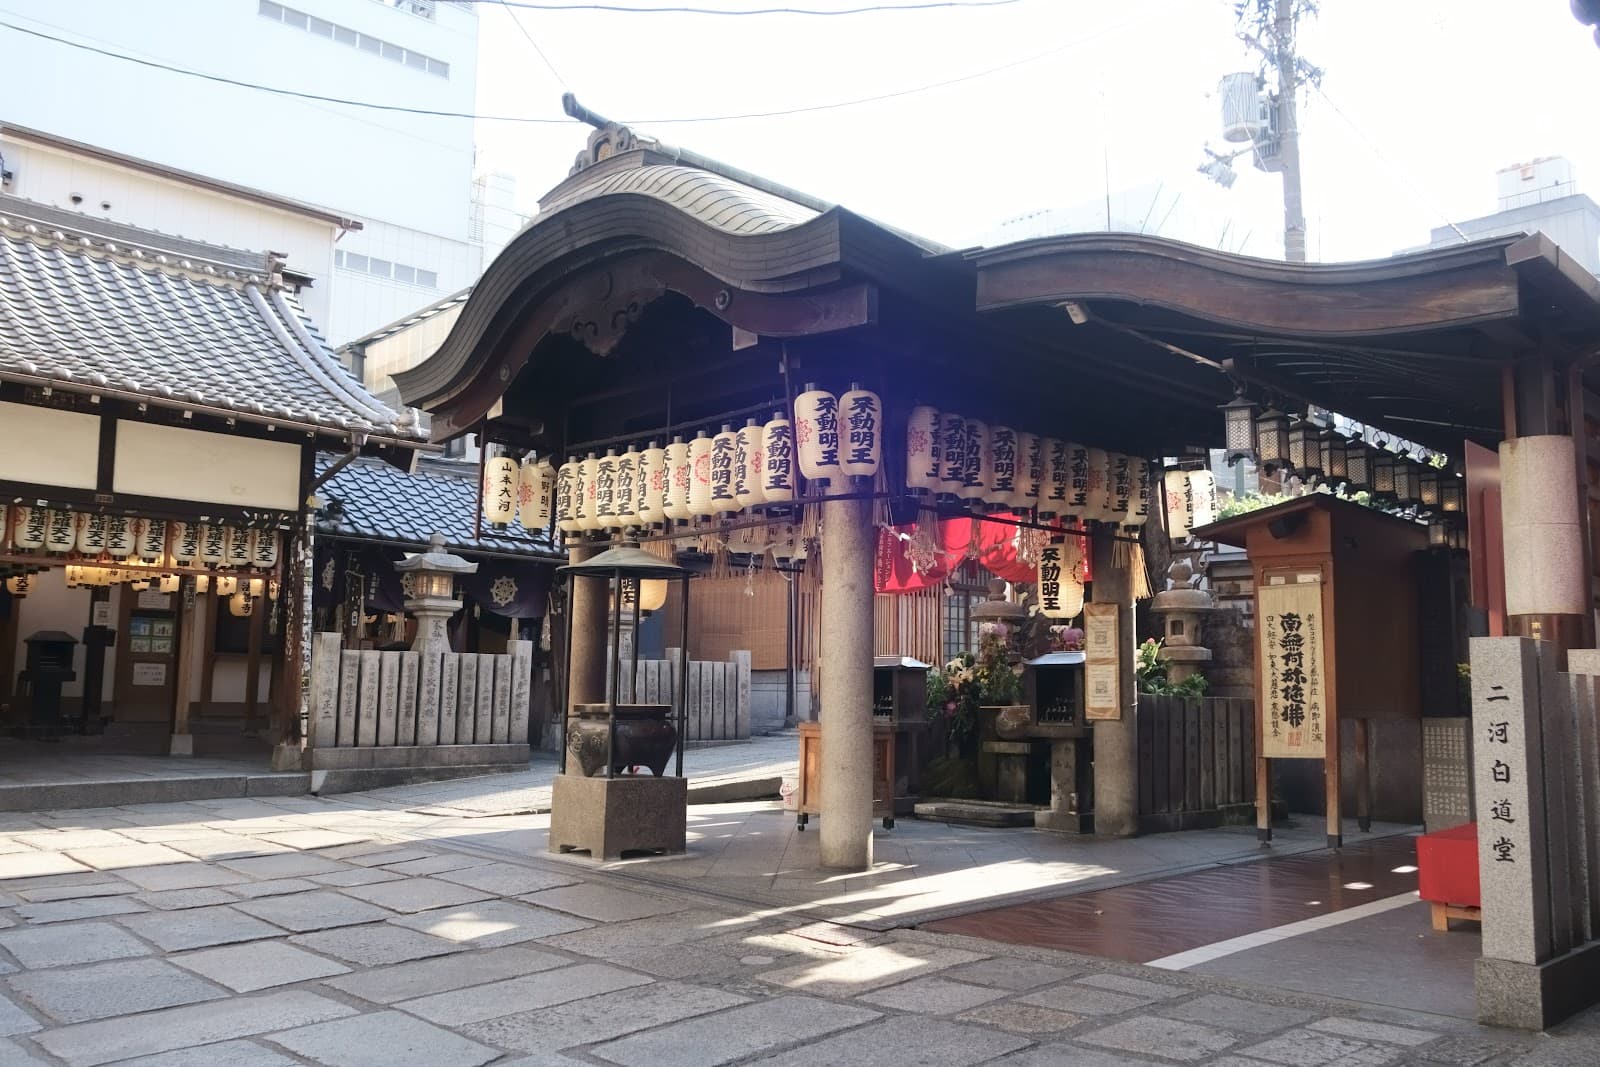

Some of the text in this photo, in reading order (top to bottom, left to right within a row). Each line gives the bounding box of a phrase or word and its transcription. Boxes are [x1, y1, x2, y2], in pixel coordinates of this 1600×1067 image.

[765, 426, 792, 490] 不動明王
[846, 396, 878, 465] 不動明王
[941, 418, 966, 482] 不動明王
[991, 430, 1016, 492] 不動明王
[498, 462, 512, 512] 山本大河
[711, 437, 735, 500] 不動明王
[1041, 548, 1061, 611] 不動明王
[1486, 686, 1516, 864] 二河白道堂
